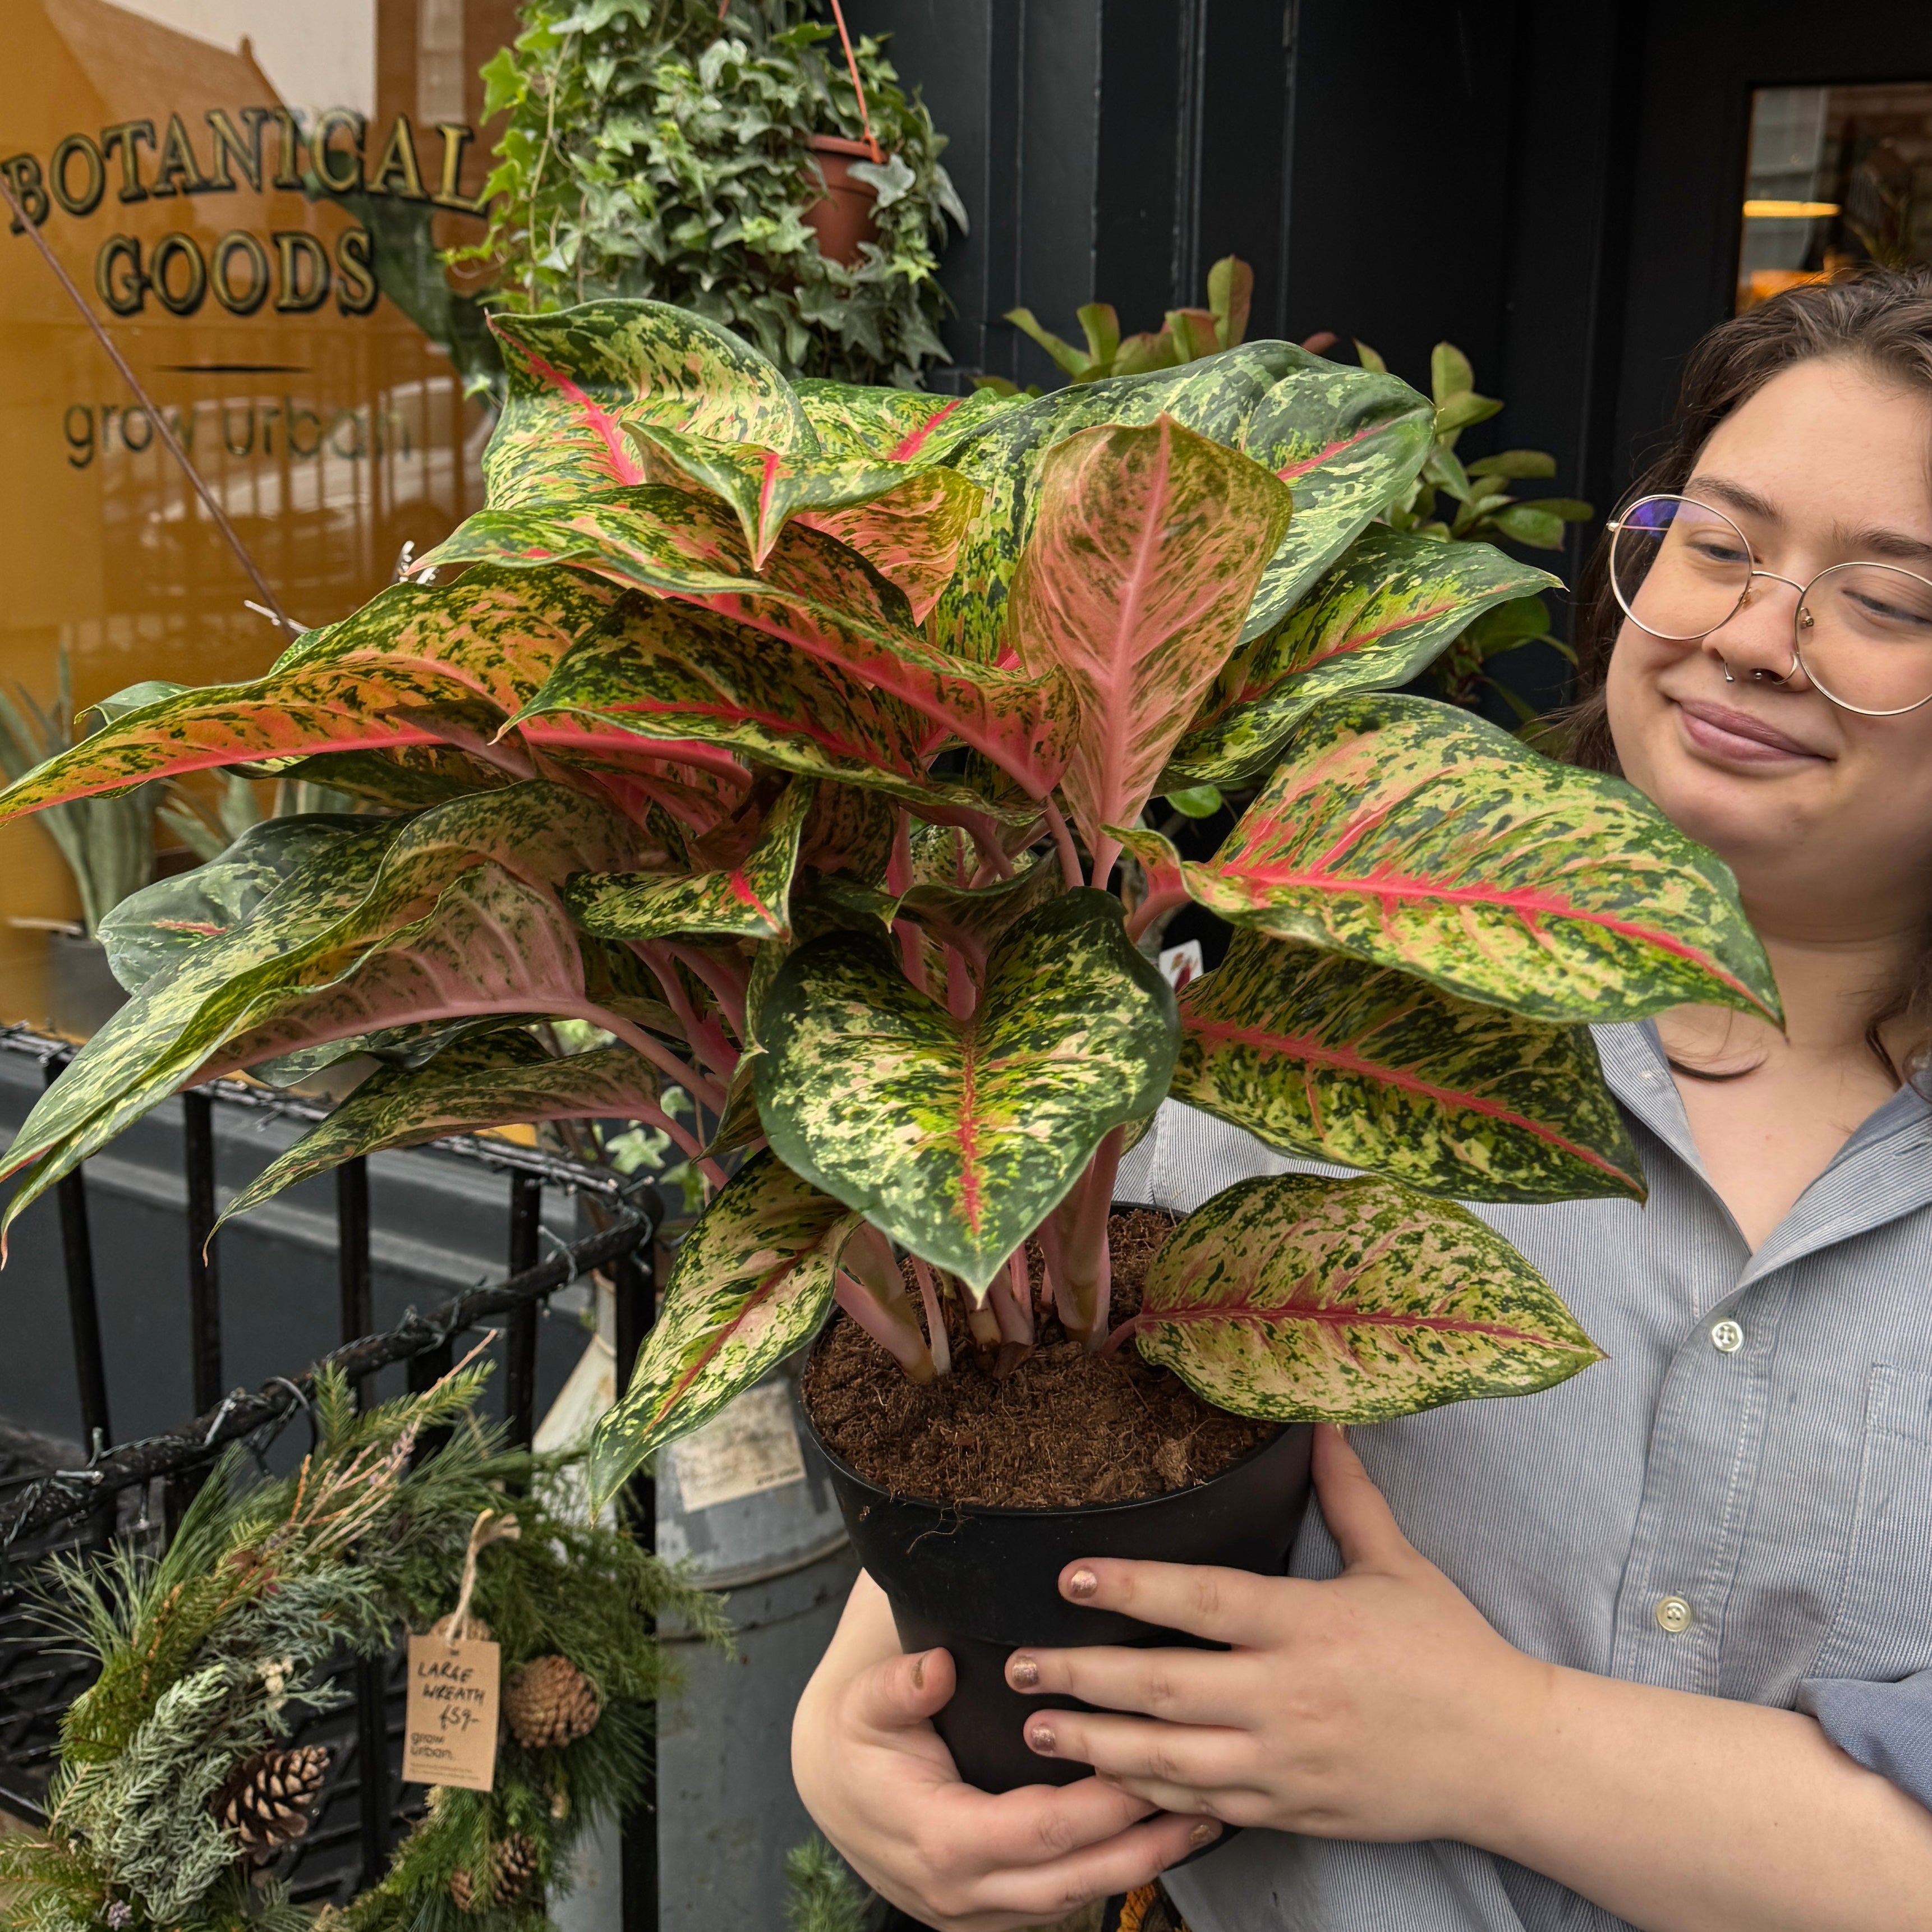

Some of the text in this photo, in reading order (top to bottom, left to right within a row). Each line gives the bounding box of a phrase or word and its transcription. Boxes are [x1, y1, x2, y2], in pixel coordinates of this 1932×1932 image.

[2, 107, 489, 234] BOTANICAL
[95, 229, 379, 315] GOODS
[63, 395, 411, 470] grow urban
[417, 1661, 473, 1682] LARGE
[422, 1683, 485, 1705] WREATH
[411, 1732, 445, 1745] grow
